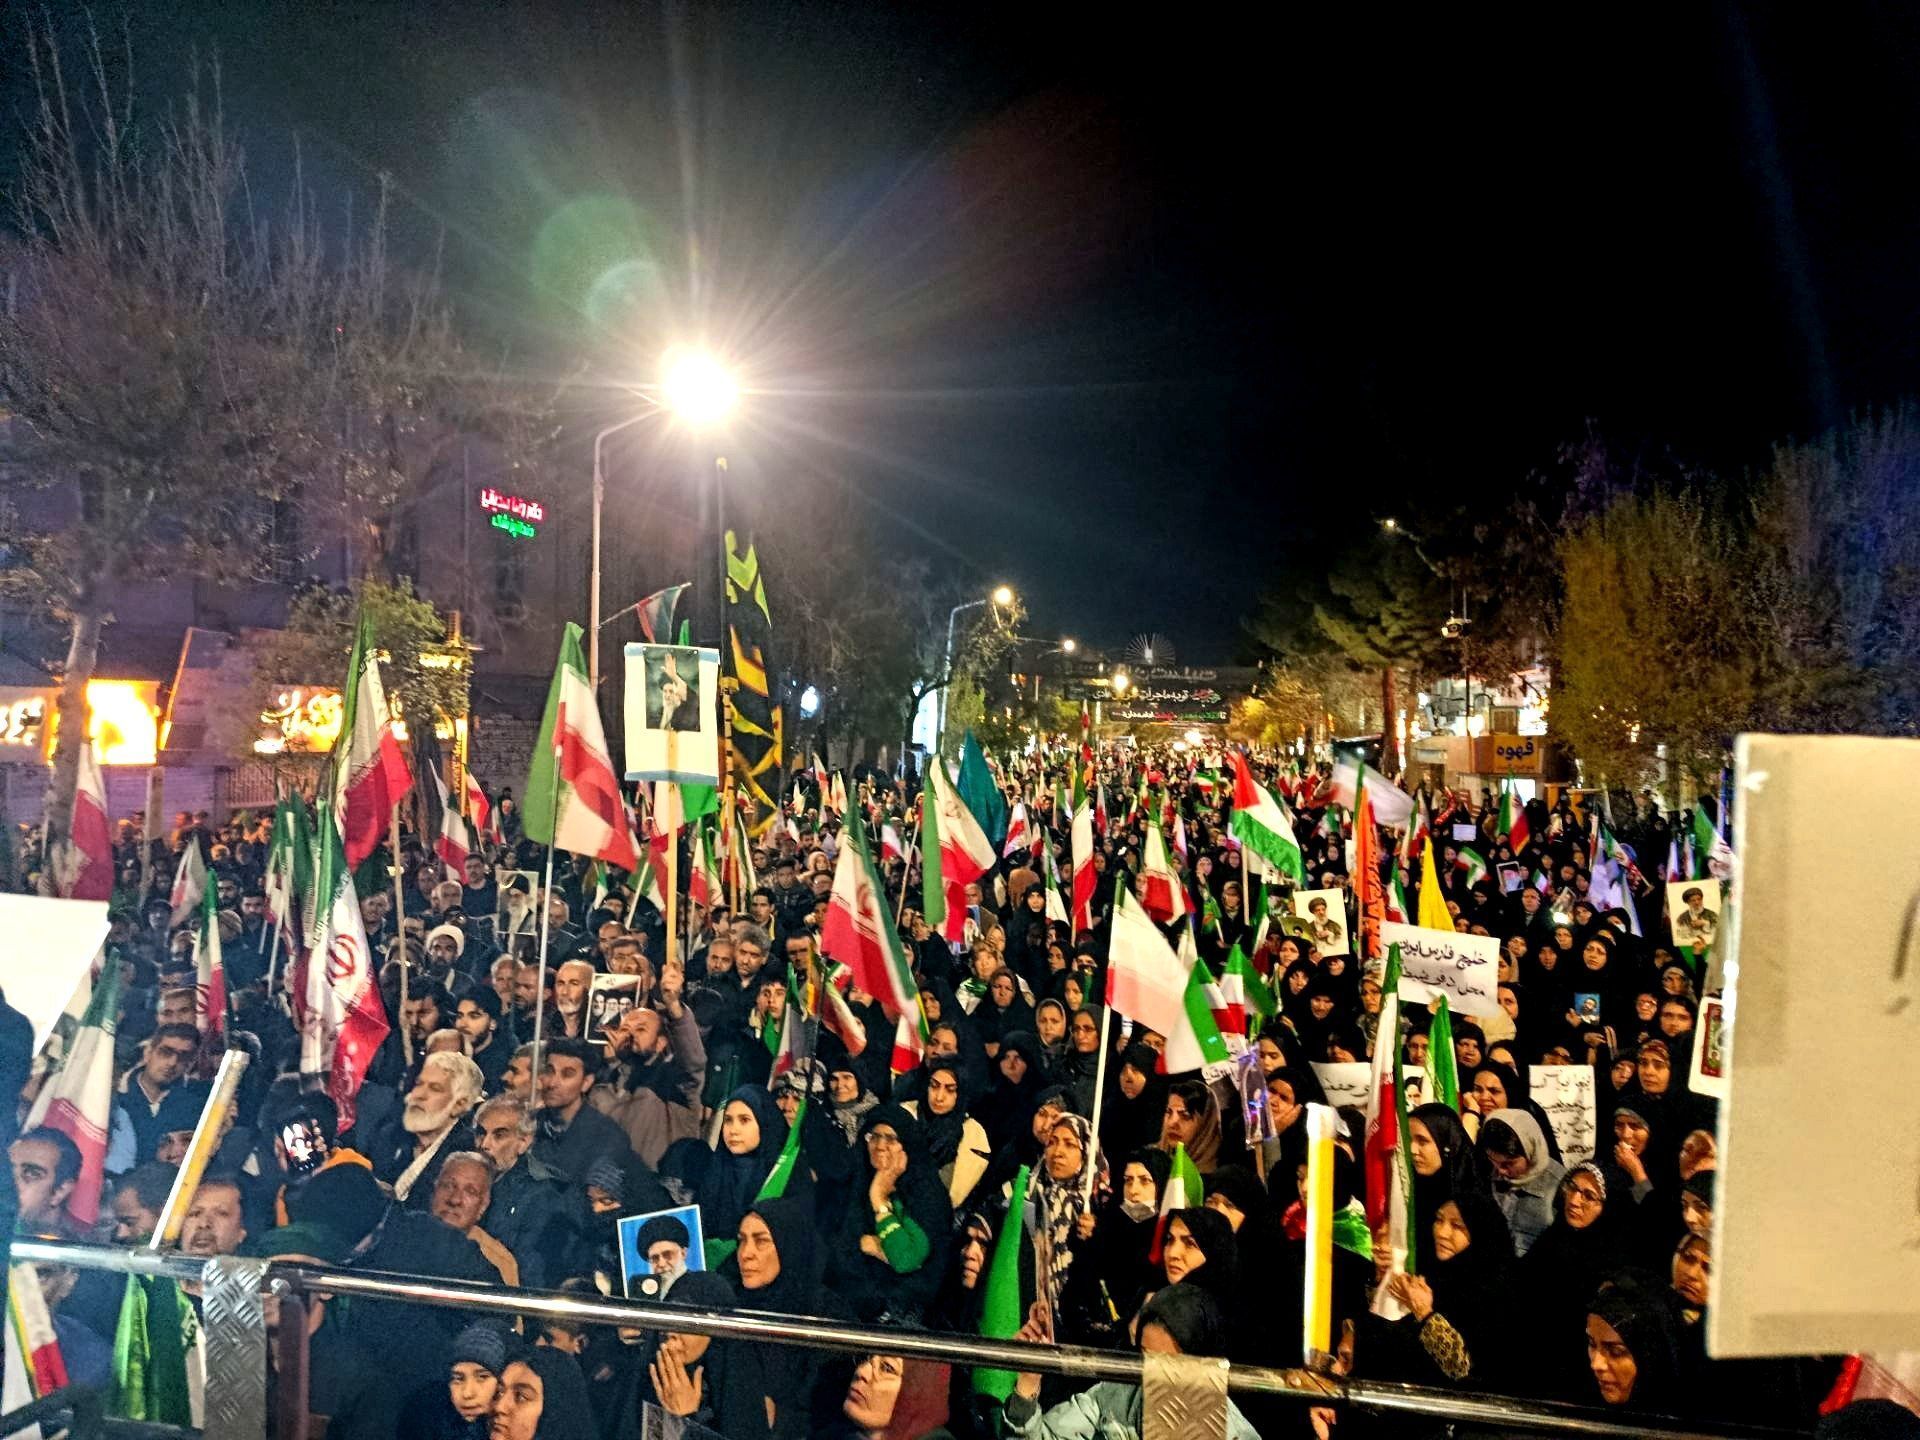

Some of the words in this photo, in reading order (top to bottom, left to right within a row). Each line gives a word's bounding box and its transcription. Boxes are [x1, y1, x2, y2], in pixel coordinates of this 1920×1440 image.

[1497, 736, 1534, 760] قهوه
[1420, 944, 1454, 961] فارس
[1456, 951, 1488, 971] خلیج
